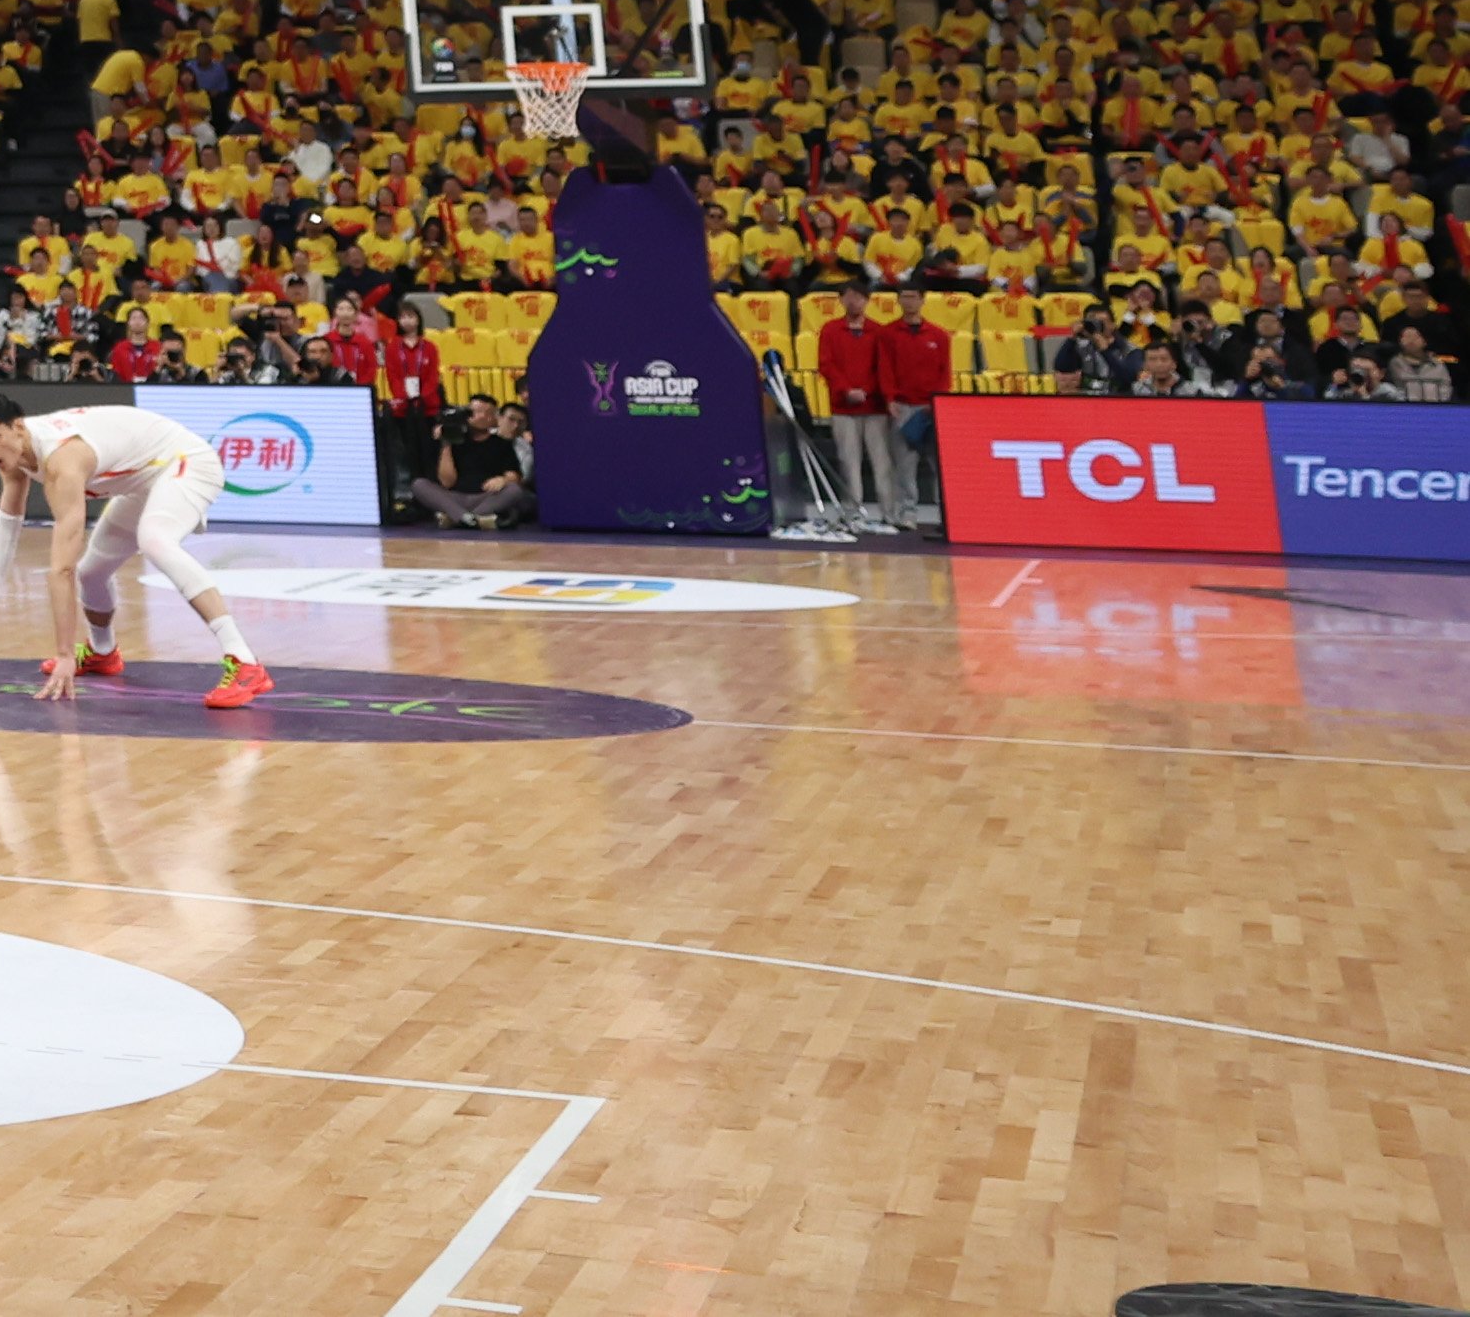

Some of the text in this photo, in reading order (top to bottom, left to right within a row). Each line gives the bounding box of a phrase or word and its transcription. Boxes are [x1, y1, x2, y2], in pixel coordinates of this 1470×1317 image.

[624, 377, 700, 396] ASIA CUP
[217, 433, 297, 472] 伊利
[991, 438, 1217, 504] TCL
